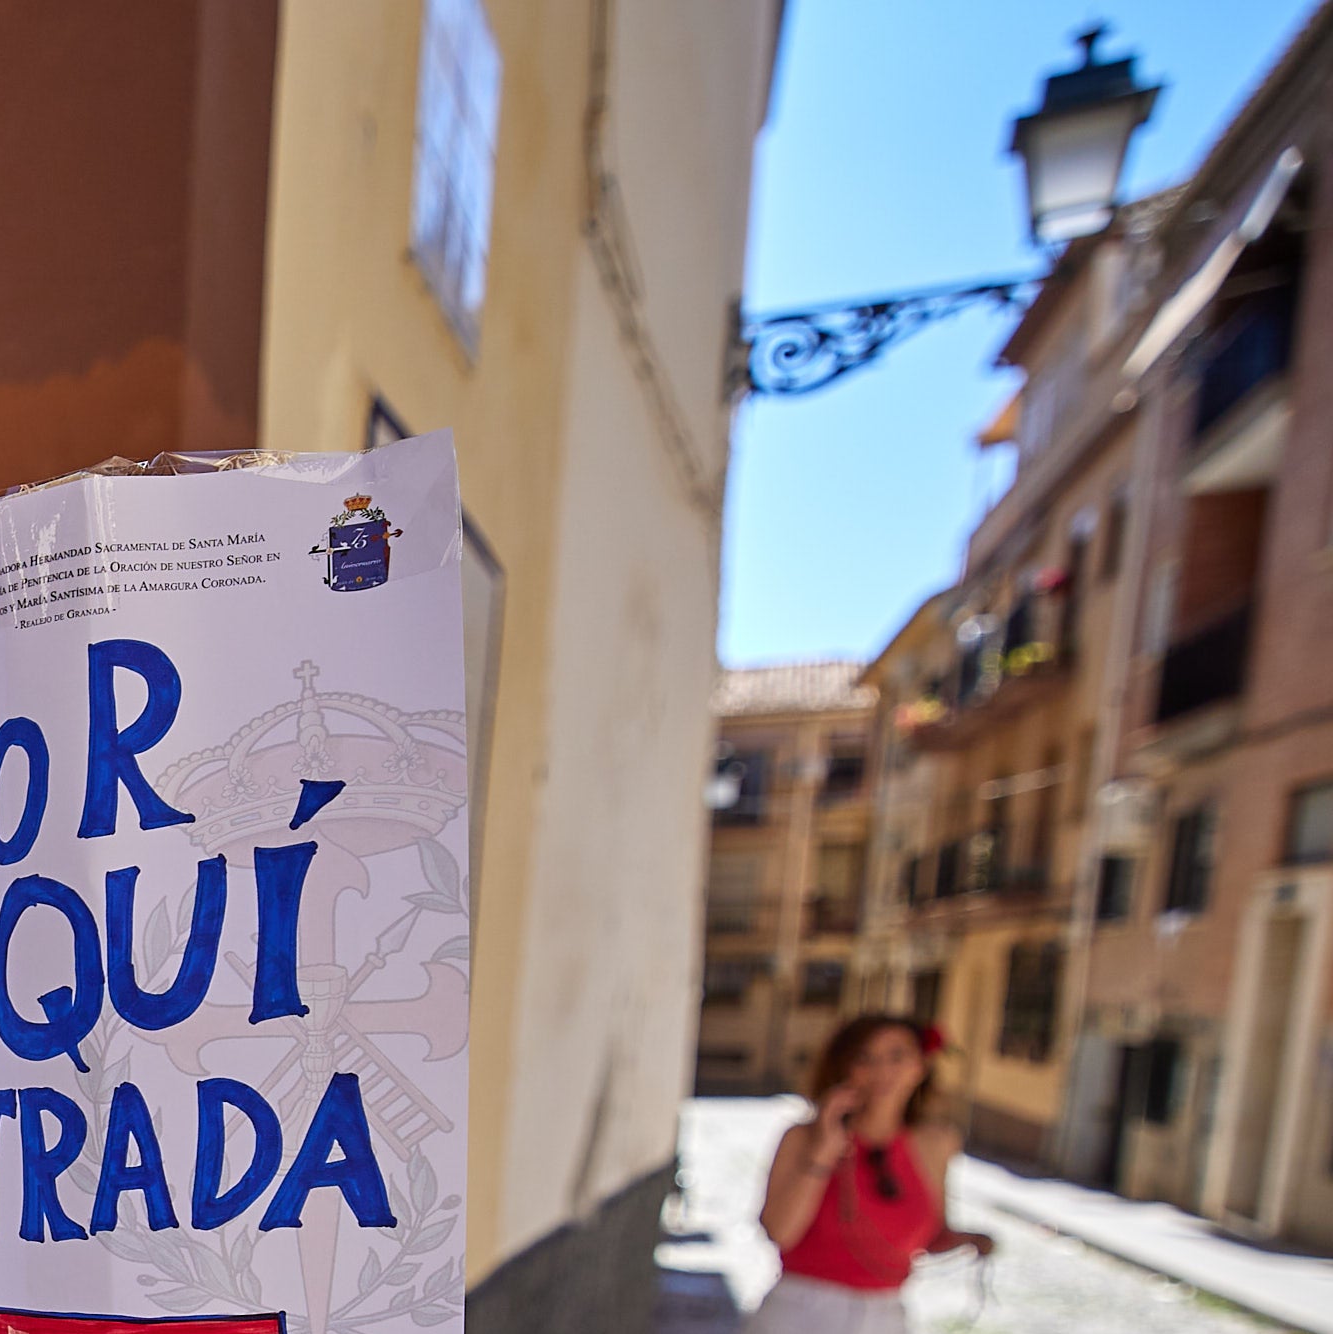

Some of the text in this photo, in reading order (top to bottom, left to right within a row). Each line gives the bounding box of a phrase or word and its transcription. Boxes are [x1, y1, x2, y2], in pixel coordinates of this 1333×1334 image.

[30, 546, 92, 567] HERMANDAD
[95, 542, 169, 554] SACRAMENTAL
[172, 542, 185, 551] DE
[189, 538, 224, 550] SANTA
[227, 532, 266, 546] MARÍA
[8, 582, 19, 593] DE
[21, 569, 74, 589] PENITENCIA
[77, 566, 90, 577] DE
[94, 565, 107, 574] LA
[110, 561, 157, 573] ORACIÓN
[160, 562, 173, 571] DE
[176, 559, 223, 571] NUESTRO
[226, 554, 263, 567] SEÑOR
[266, 552, 281, 562] EN
[16, 594, 48, 611] MARÍA
[50, 586, 104, 603] SANTÍSIMA
[107, 584, 120, 594] DE
[124, 583, 137, 593] LA
[139, 581, 198, 592] AMARGURA
[201, 575, 266, 589] CORONADA.
[20, 607, 110, 630] REALEJO DE GRANADA
